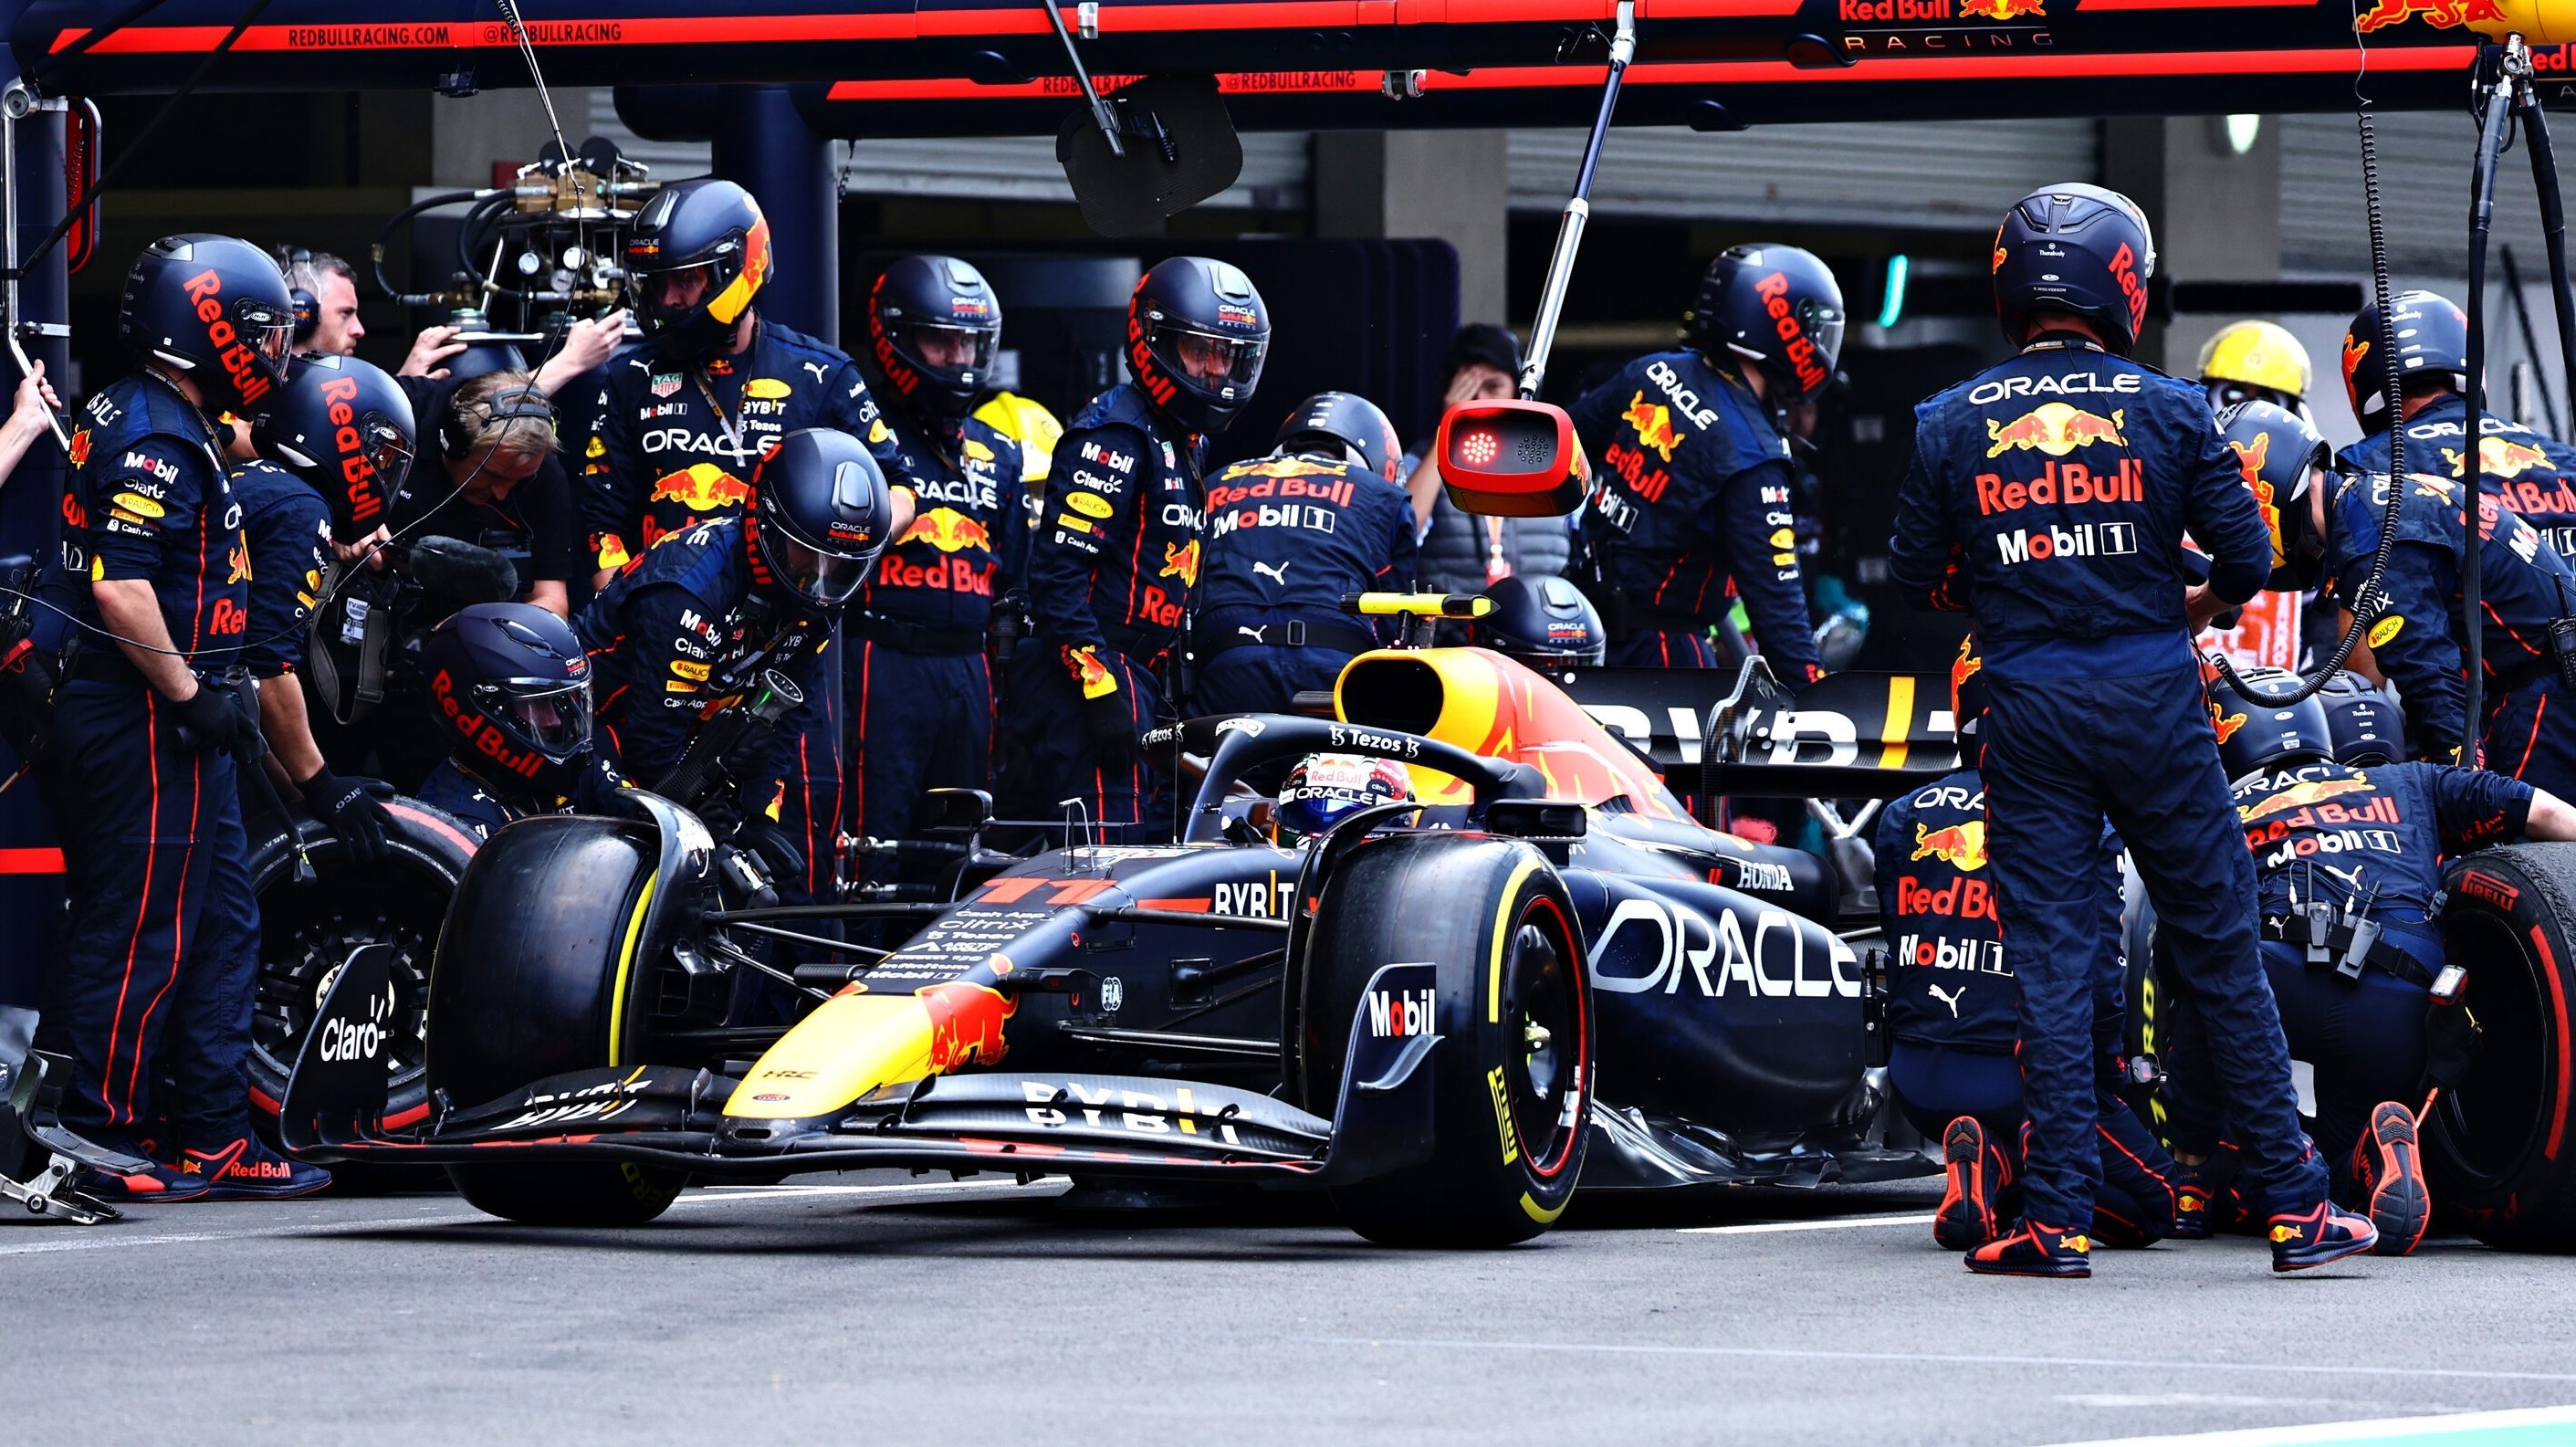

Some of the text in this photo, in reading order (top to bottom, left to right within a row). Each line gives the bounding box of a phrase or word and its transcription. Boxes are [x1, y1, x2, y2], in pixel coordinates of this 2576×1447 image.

[288, 26, 450, 46] REDBULLRACING.COM
[1844, 33, 2053, 49] RACING
[2527, 43, 2567, 71] ed
[1226, 70, 1356, 90] @REDBULLRACING
[2039, 249, 2066, 257] Therabody
[183, 268, 271, 406] Red Bull
[1754, 271, 1826, 393] Red Bull
[1646, 361, 1719, 431] ORACLE
[1968, 372, 2141, 404] ORACLE
[640, 403, 673, 420] Mobil
[750, 419, 782, 432] Tezos
[320, 376, 382, 522] Red Bull
[642, 428, 782, 456] ORACLE
[124, 451, 179, 485] Mobil
[1081, 442, 1135, 474] Mobil
[912, 477, 998, 509] RACLE
[1073, 469, 1123, 494] Claro
[1205, 477, 1355, 515] Red Bull
[1975, 458, 2143, 516] Red Bull
[121, 523, 141, 535] Cash
[831, 521, 871, 534] ORACLE
[1213, 504, 1335, 540] Mobil 1
[1067, 536, 1085, 549] Cash
[1996, 522, 2138, 565] Mobil 1
[878, 553, 948, 590] Red
[2375, 619, 2399, 641] RAUCH
[1149, 728, 1173, 744] Tezos
[1352, 728, 1402, 752] Tezos
[474, 724, 545, 778] Bull
[1310, 770, 1362, 785] Red Bull
[1295, 785, 1374, 805] ORACLE
[2316, 796, 2400, 823] Bull
[2267, 829, 2363, 868] Mobil
[1736, 862, 1795, 891] HONDA
[2460, 870, 2519, 912] PIRELLI
[977, 877, 1117, 906] 11
[1898, 875, 1962, 916] Red
[938, 918, 1033, 930] citrix
[956, 910, 1046, 920] Cash App
[951, 931, 1015, 940] Tezos
[1588, 898, 1863, 999] ORACLE
[1899, 934, 1977, 970] Mobil
[864, 970, 932, 980] Mobil
[1367, 988, 1436, 1037] Mobil
[320, 1007, 387, 1063] Claro
[1021, 1081, 1253, 1145] BYBIT
[1487, 1064, 1518, 1167] PIRELLI
[230, 1161, 292, 1178] Red Bull
